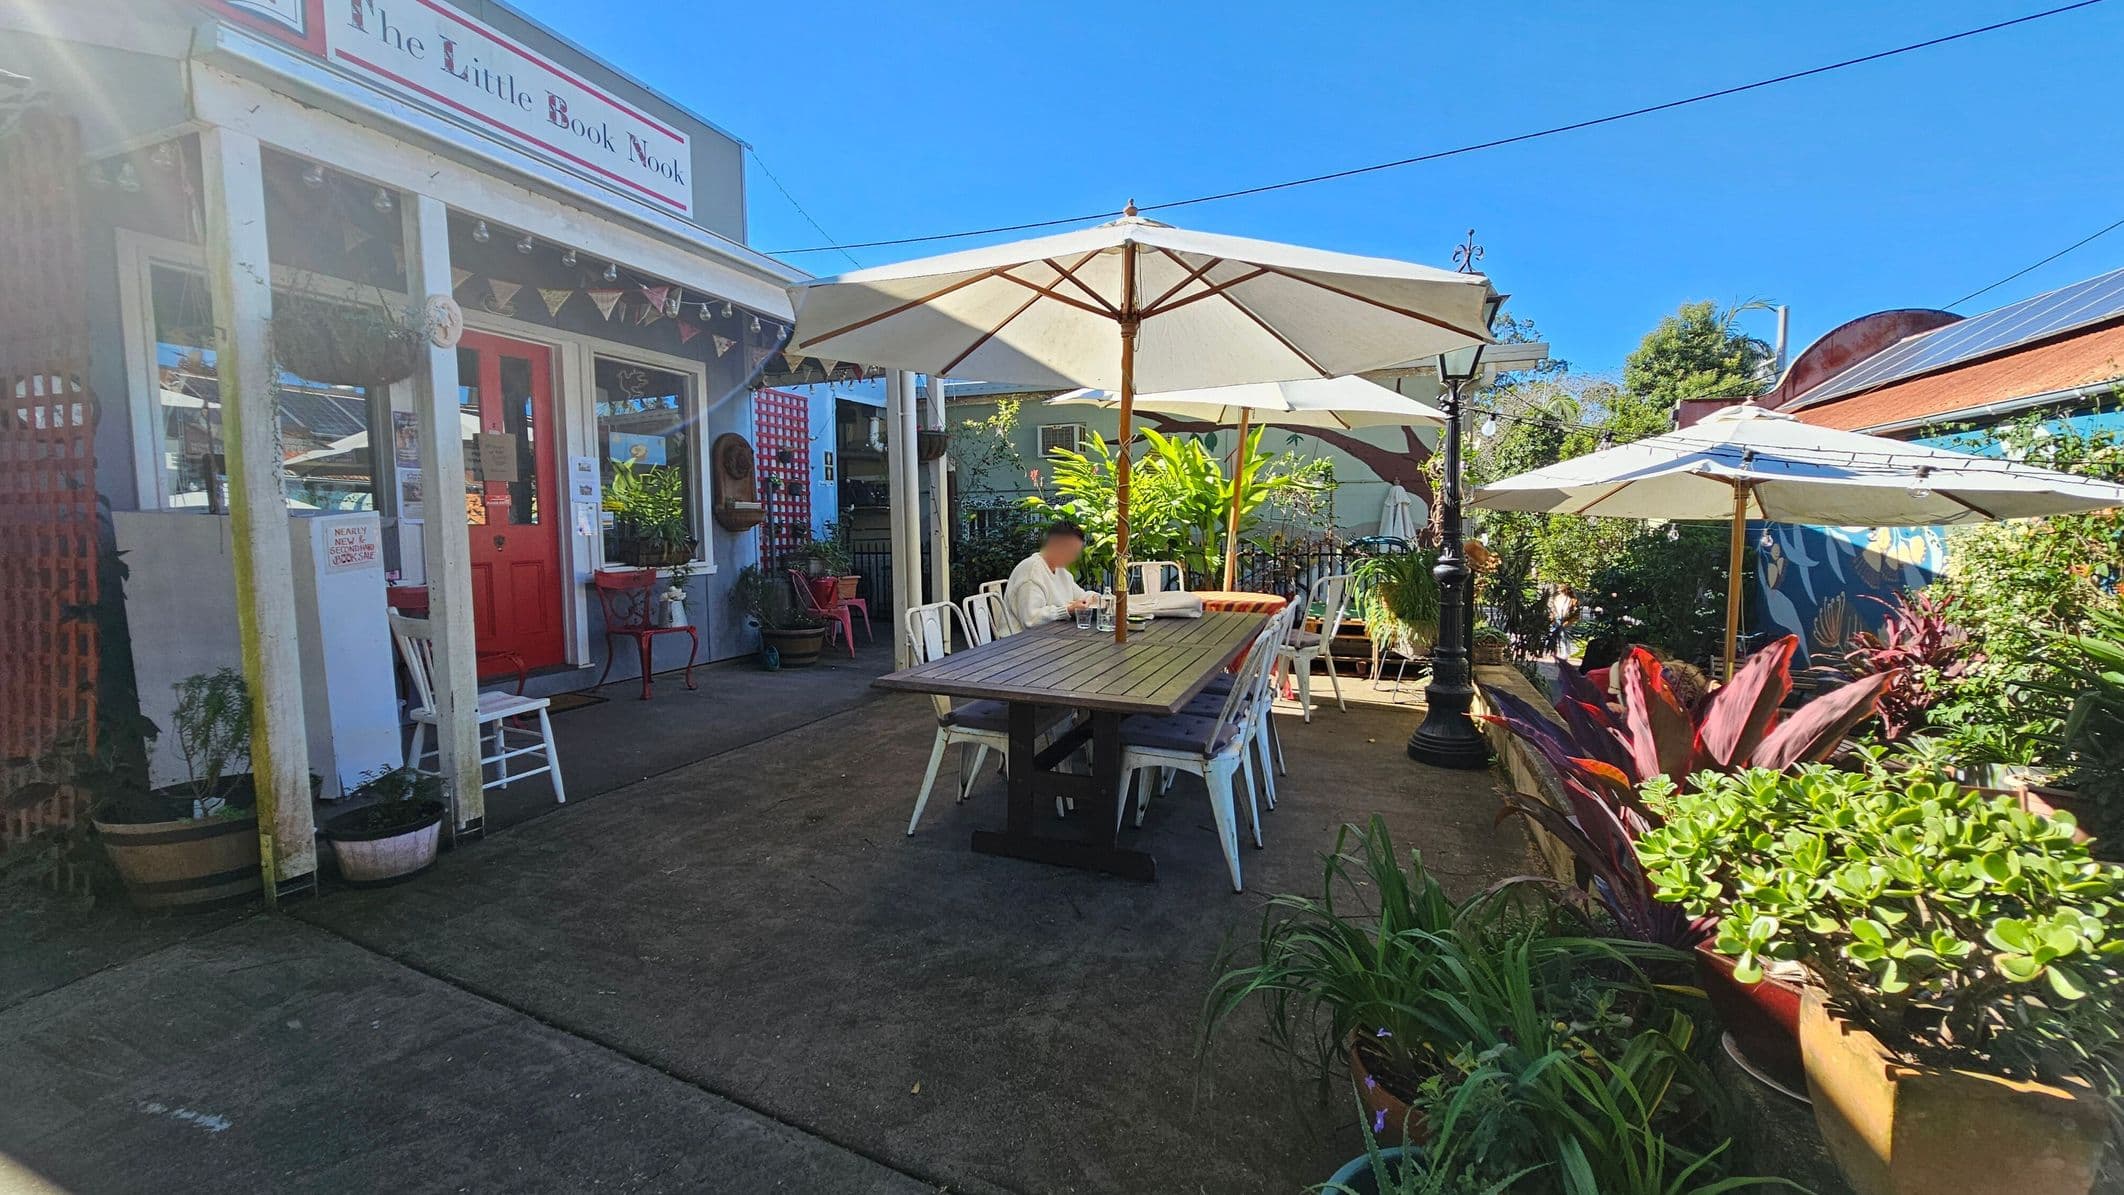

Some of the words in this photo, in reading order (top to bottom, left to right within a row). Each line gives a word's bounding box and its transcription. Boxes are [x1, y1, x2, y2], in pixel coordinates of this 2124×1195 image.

[347, 0, 425, 60] The
[438, 34, 532, 112] Little
[544, 89, 617, 153] Book
[625, 130, 686, 186] Nook
[335, 526, 367, 536] NEARLY
[335, 537, 354, 546] NEW
